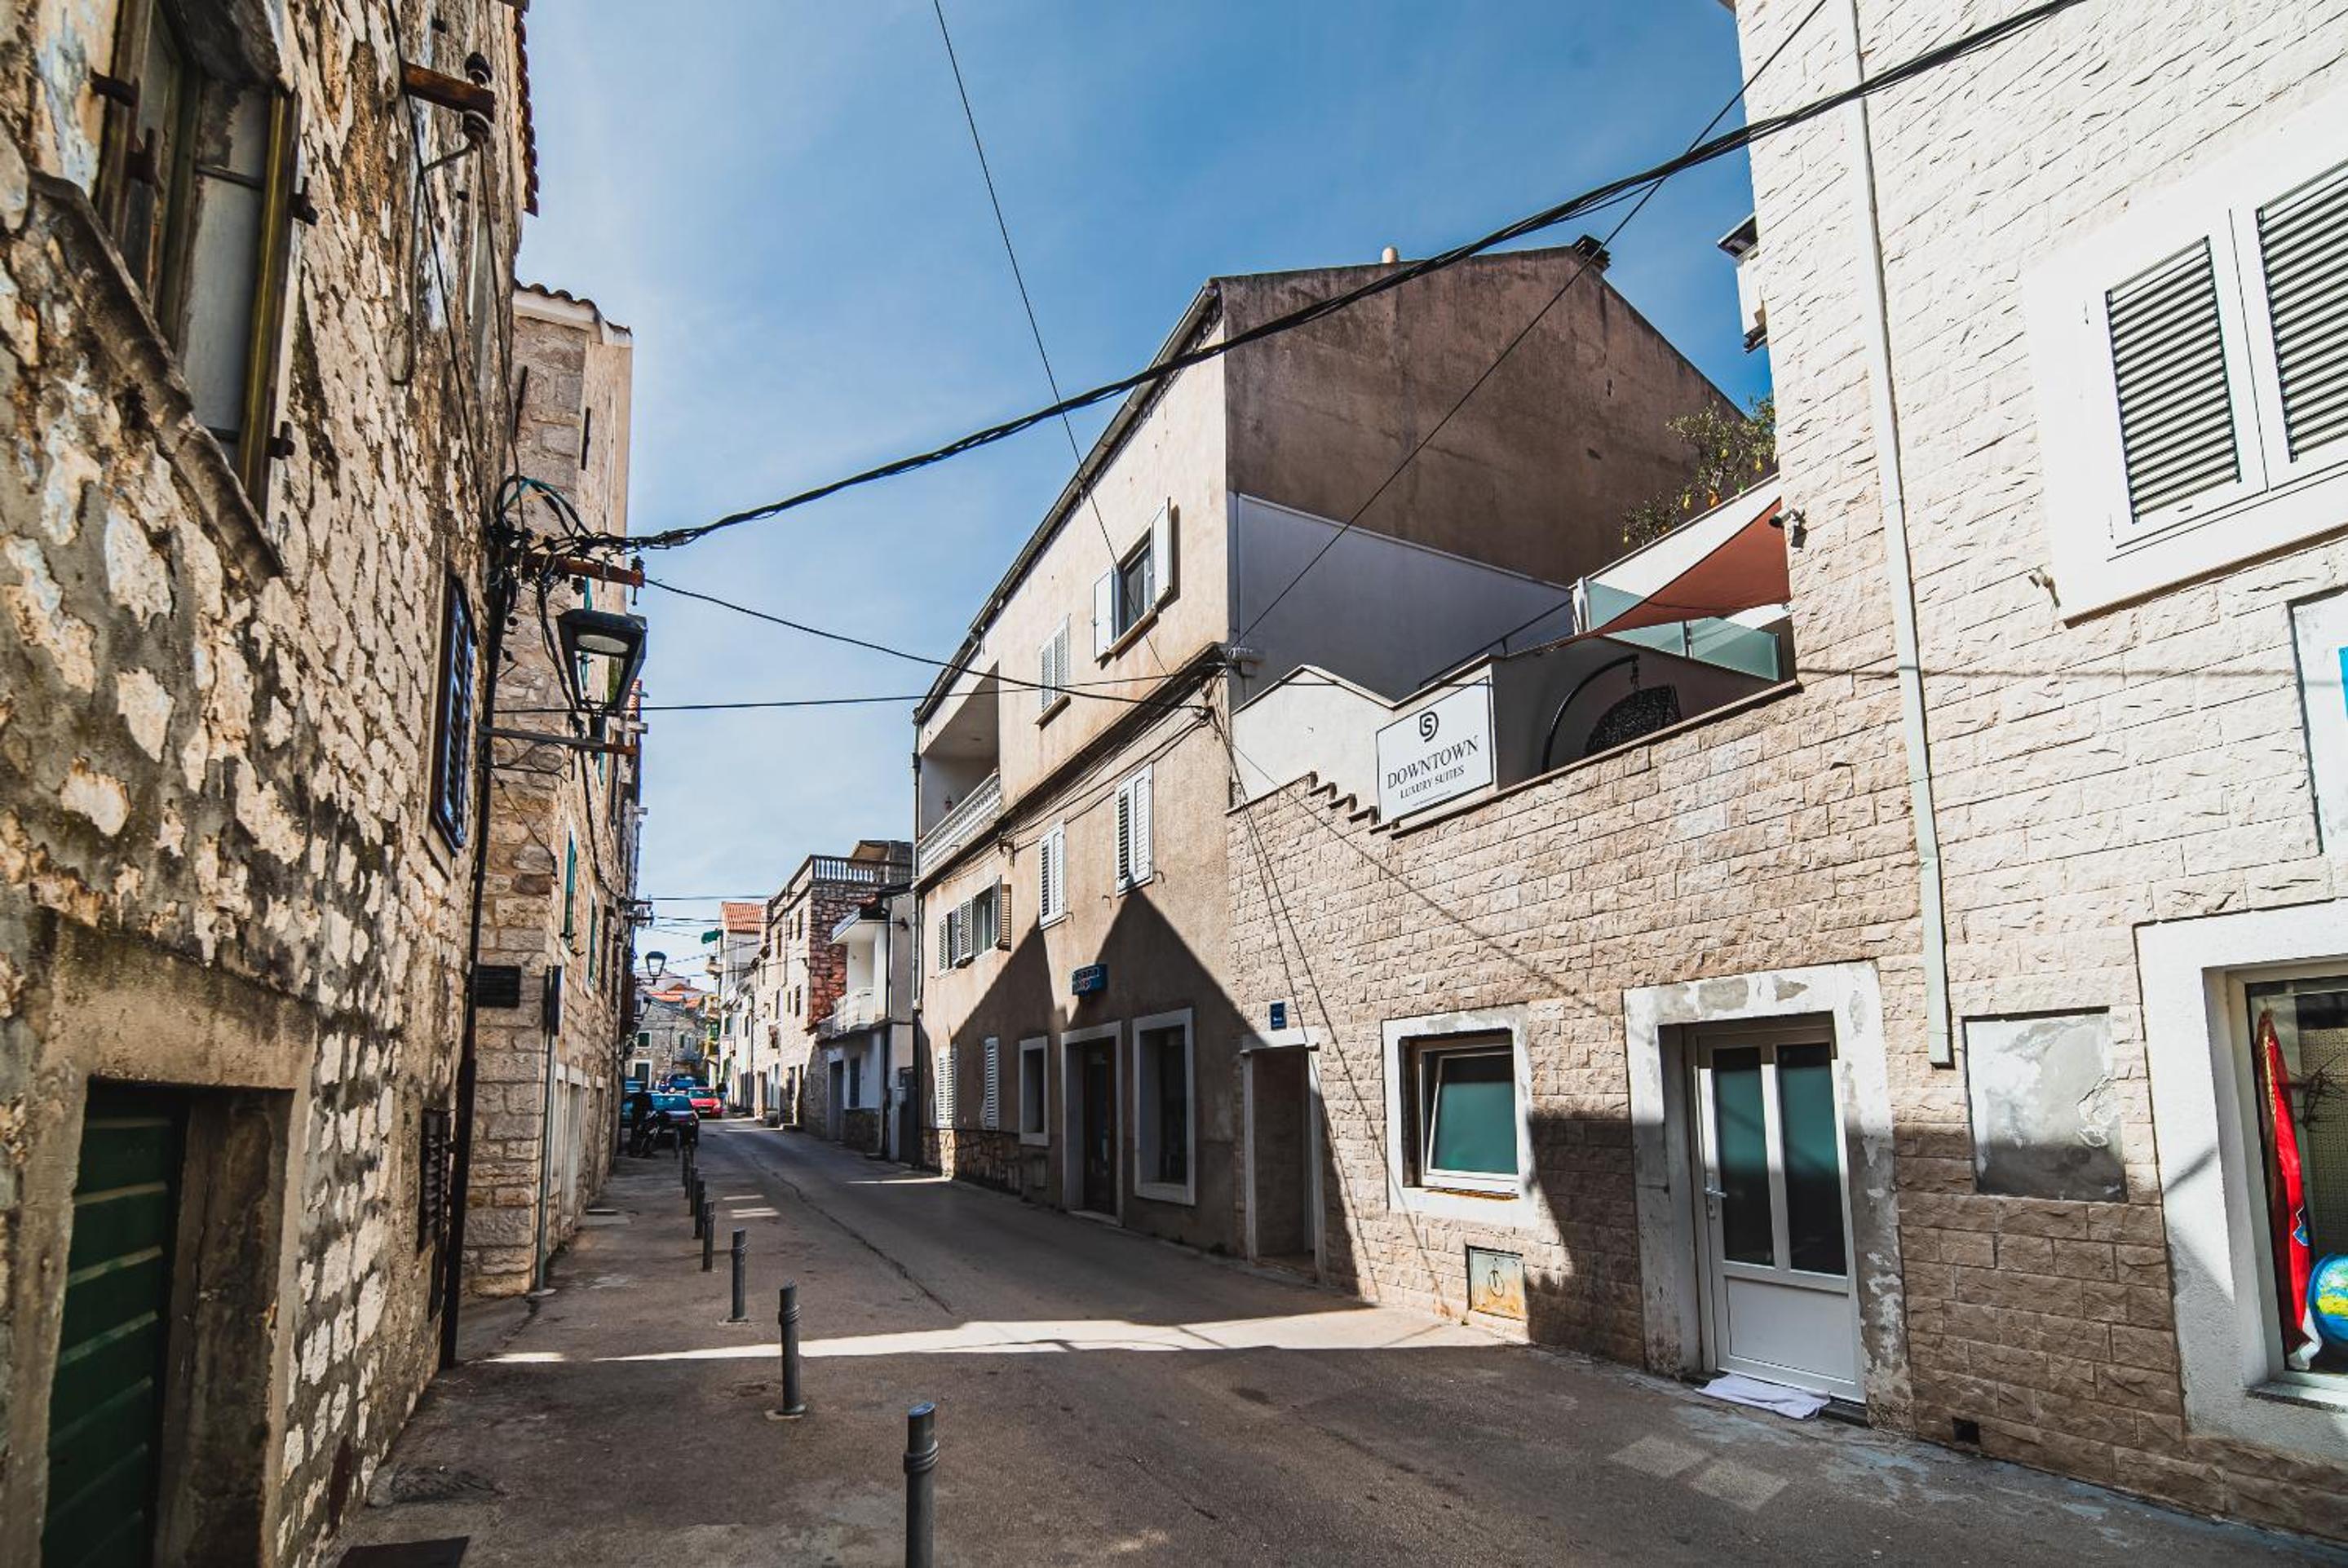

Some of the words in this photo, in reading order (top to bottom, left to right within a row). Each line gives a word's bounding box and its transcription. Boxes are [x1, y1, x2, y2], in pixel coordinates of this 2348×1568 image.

[1387, 735, 1478, 789] DOWNTOWN
[1400, 777, 1433, 799] LUXURY
[1435, 765, 1465, 784] SUITES
